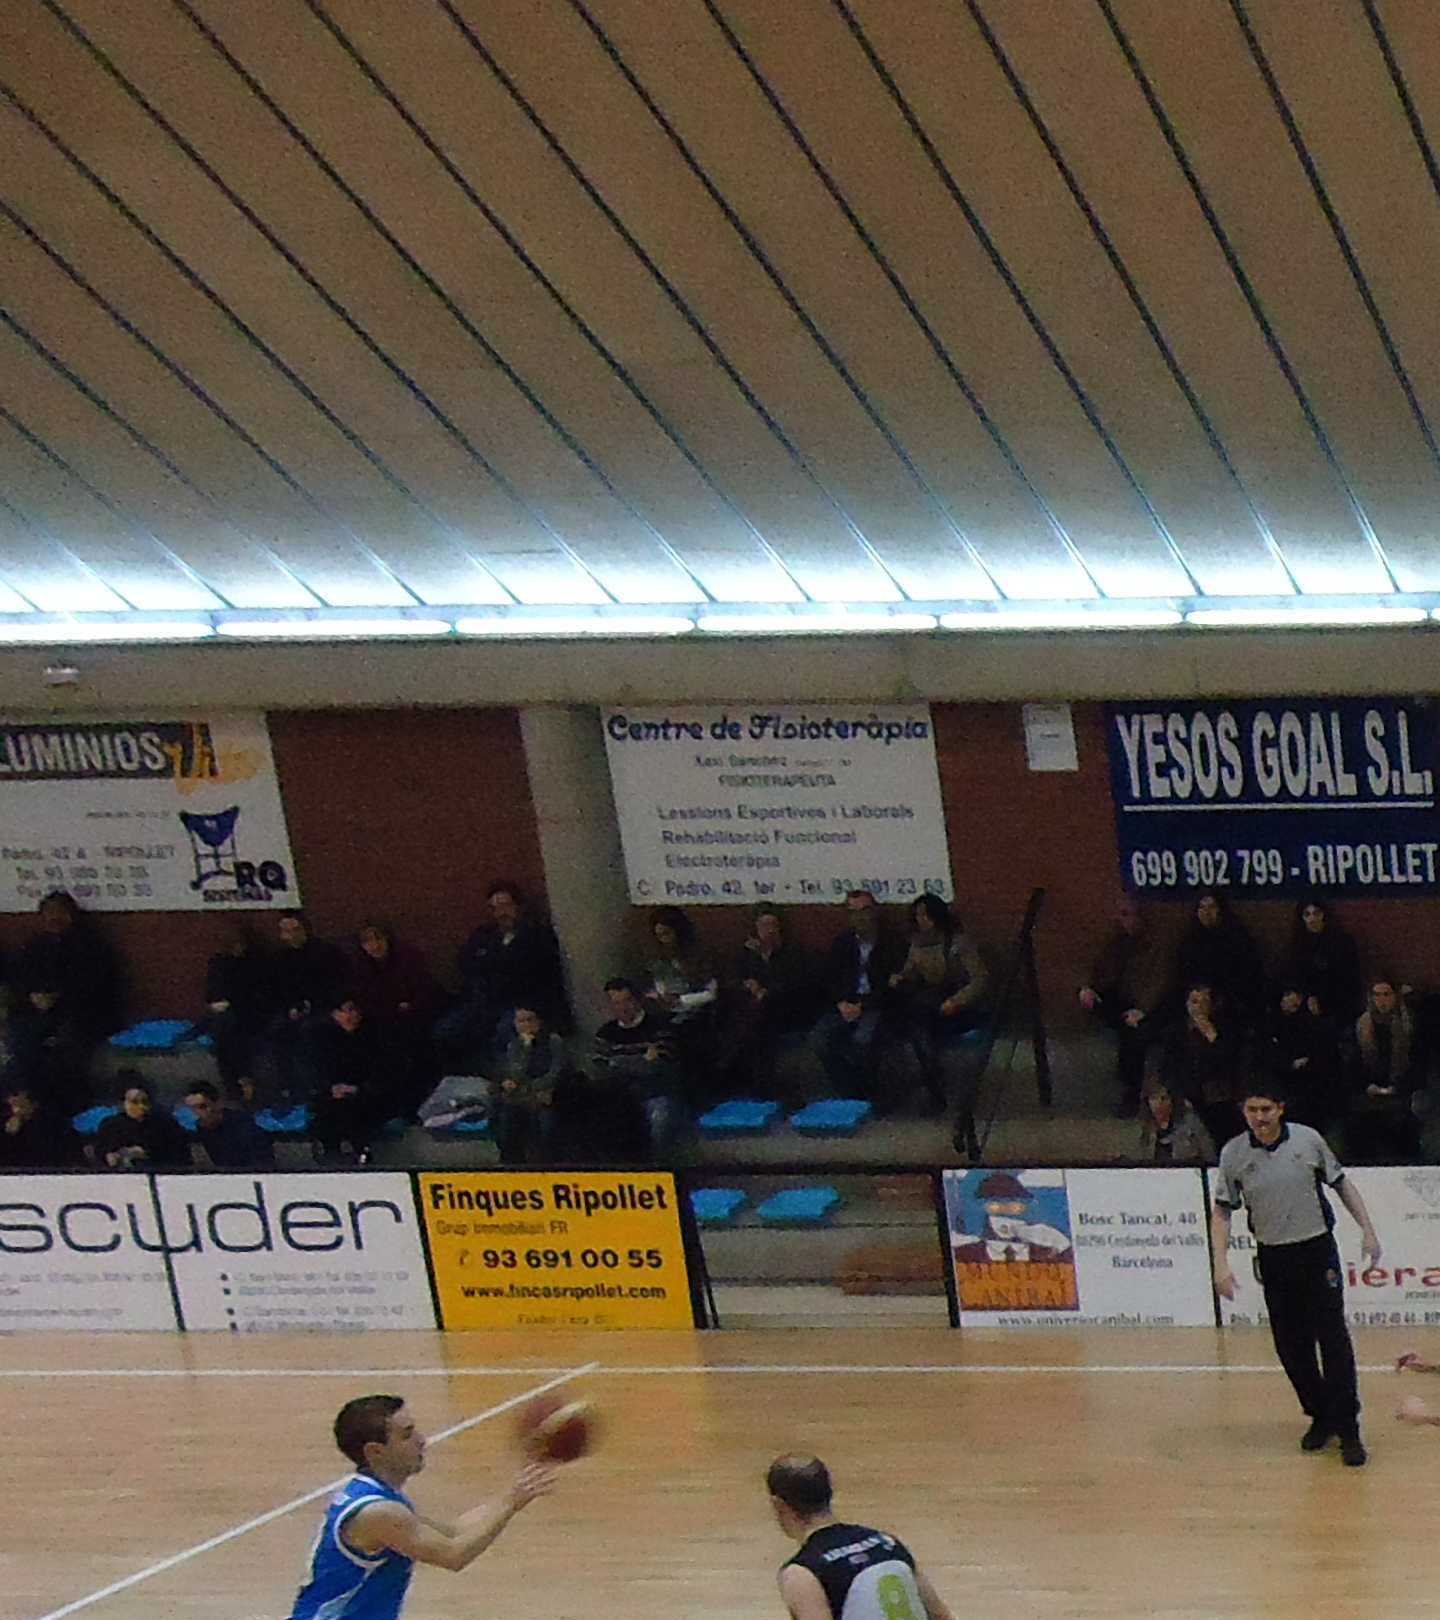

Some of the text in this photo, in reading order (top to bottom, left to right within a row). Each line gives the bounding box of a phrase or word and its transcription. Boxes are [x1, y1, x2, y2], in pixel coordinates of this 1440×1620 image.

[607, 714, 705, 742] Centre
[710, 714, 743, 742] de
[1116, 709, 1434, 799] YESOS GOAL S.L.
[1131, 850, 1178, 887] 699
[1184, 849, 1231, 885] 902
[1237, 848, 1283, 885] 799
[1307, 843, 1439, 884] RIPOLLET
[429, 1182, 669, 1217] Finques Ripollet
[482, 1249, 663, 1268] 93 691 00 55
[1112, 1256, 1173, 1269] Barcelona
